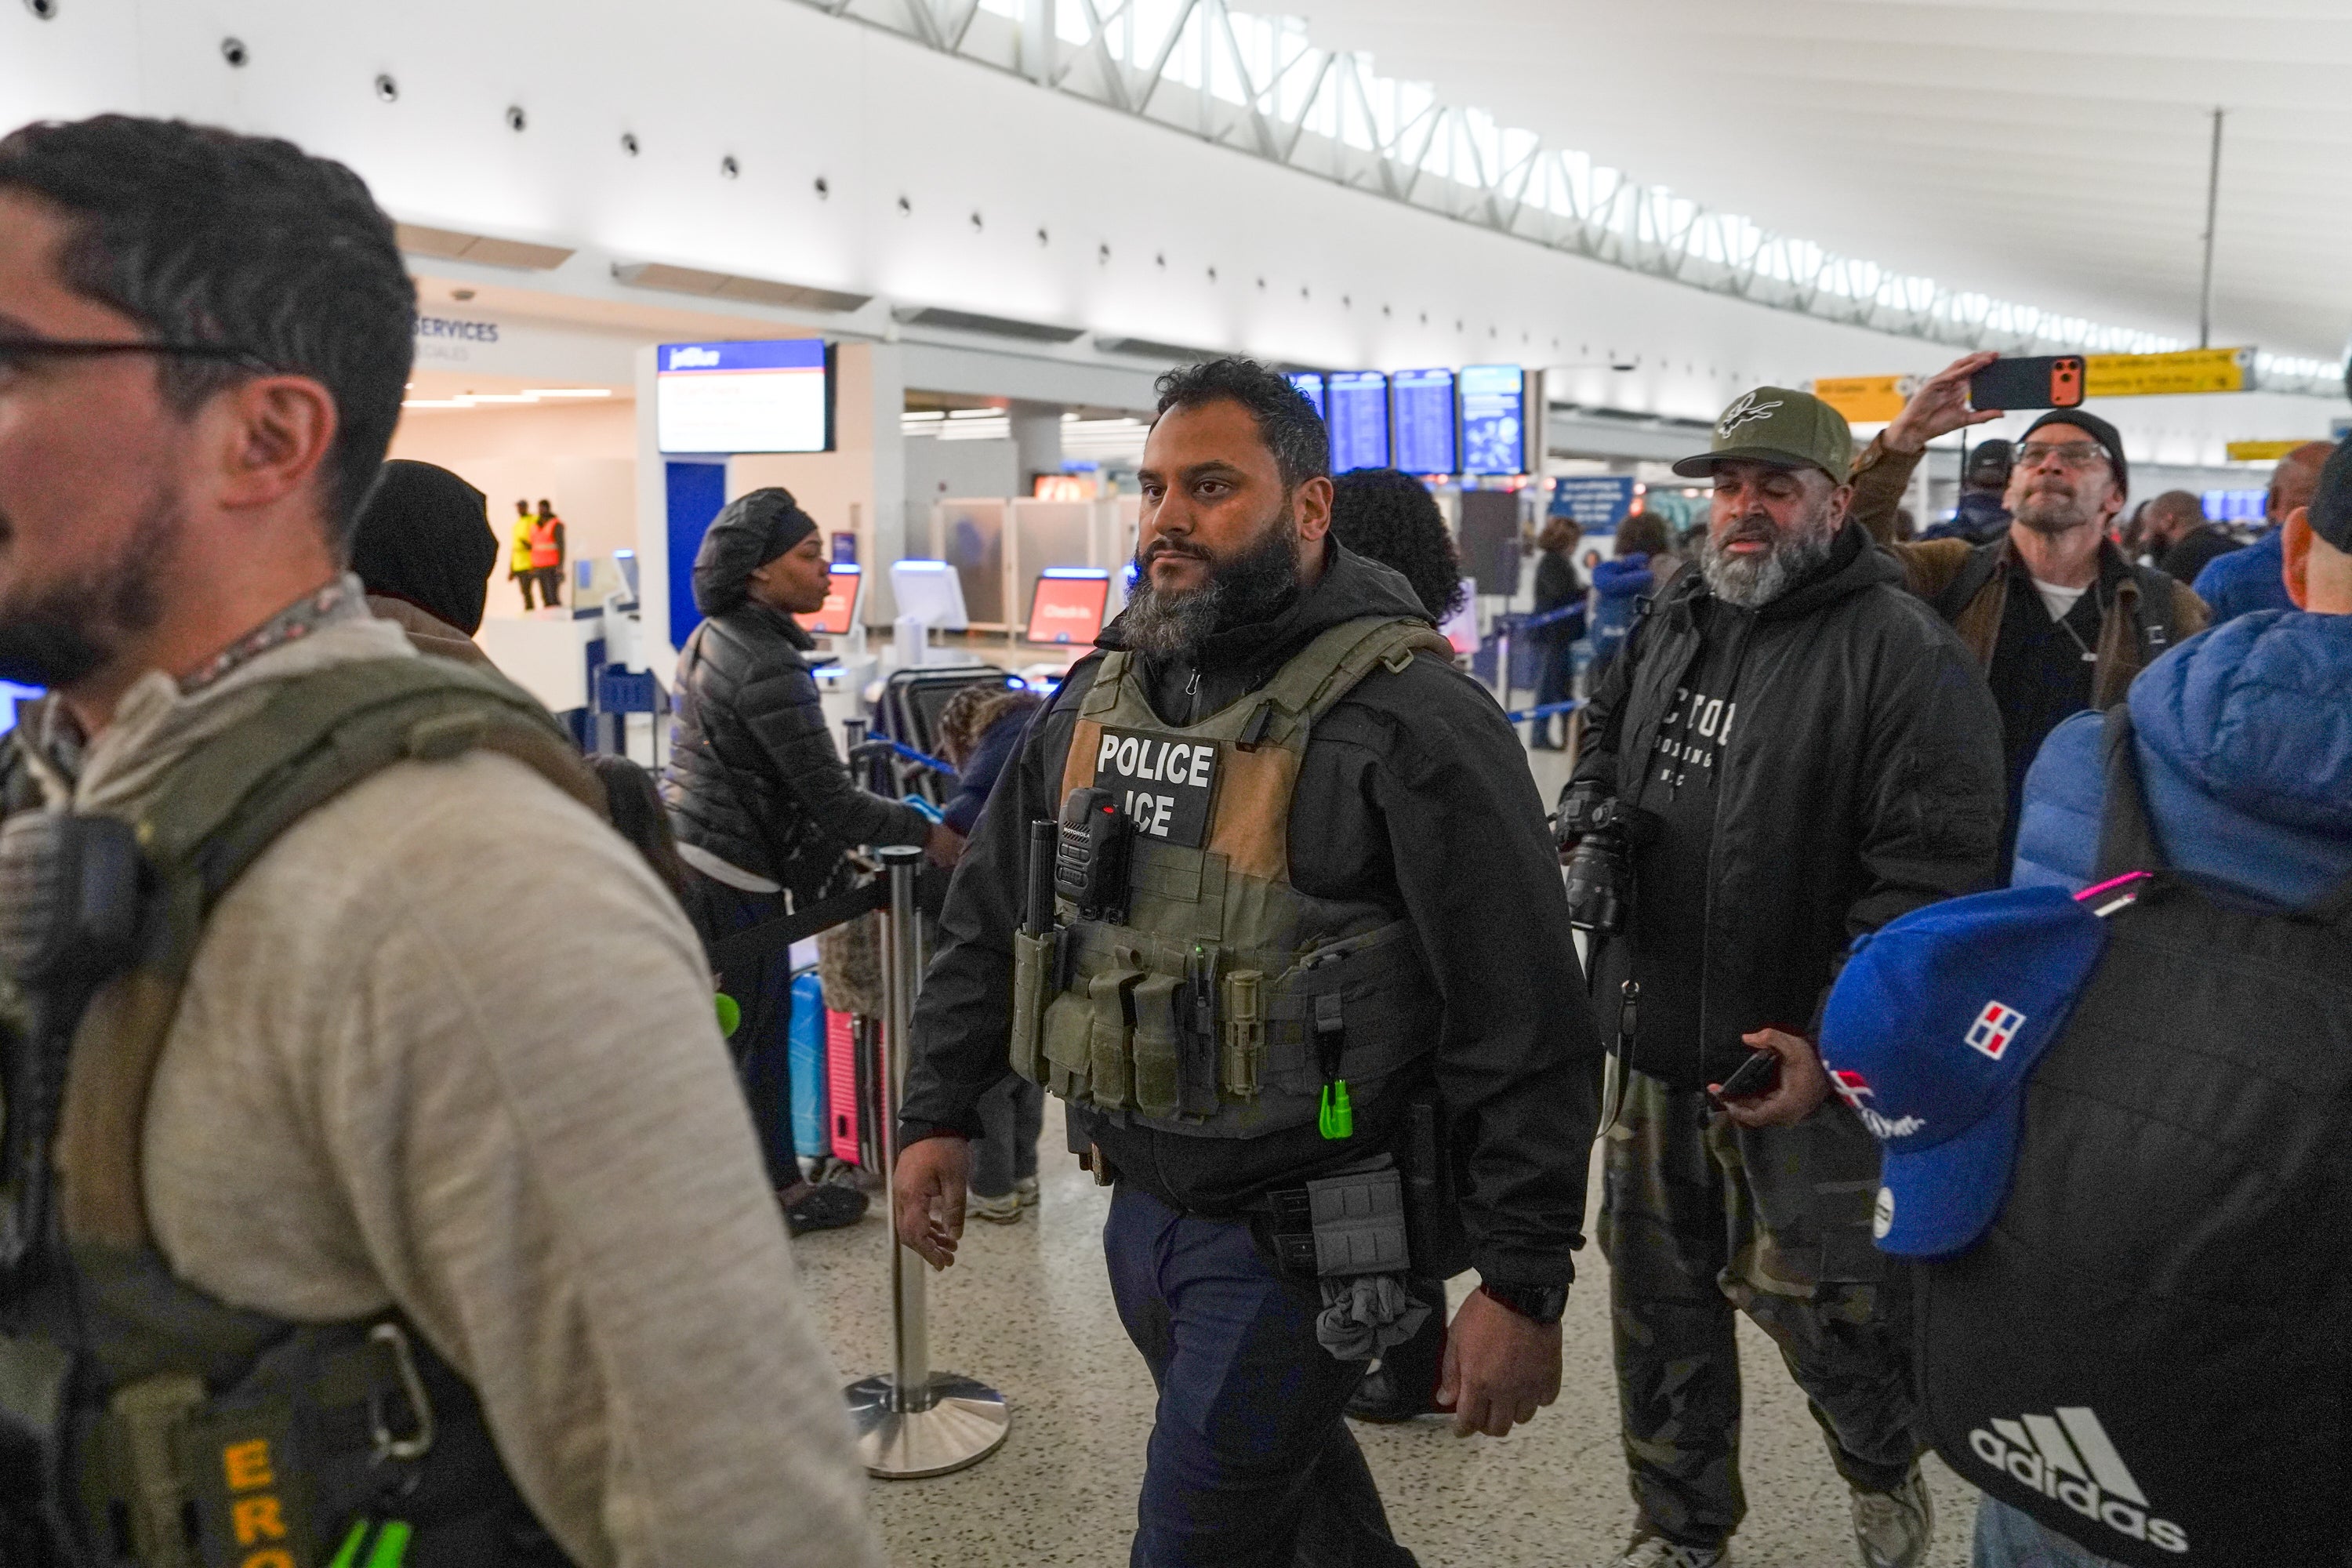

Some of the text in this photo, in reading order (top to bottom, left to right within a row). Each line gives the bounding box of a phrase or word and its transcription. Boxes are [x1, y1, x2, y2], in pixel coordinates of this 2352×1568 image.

[1098, 734, 1214, 788] POLICE
[1063, 827, 1091, 839] MOTOROLA
[1125, 789, 1174, 837] ICE
[1968, 1428, 2189, 1554] adidas
